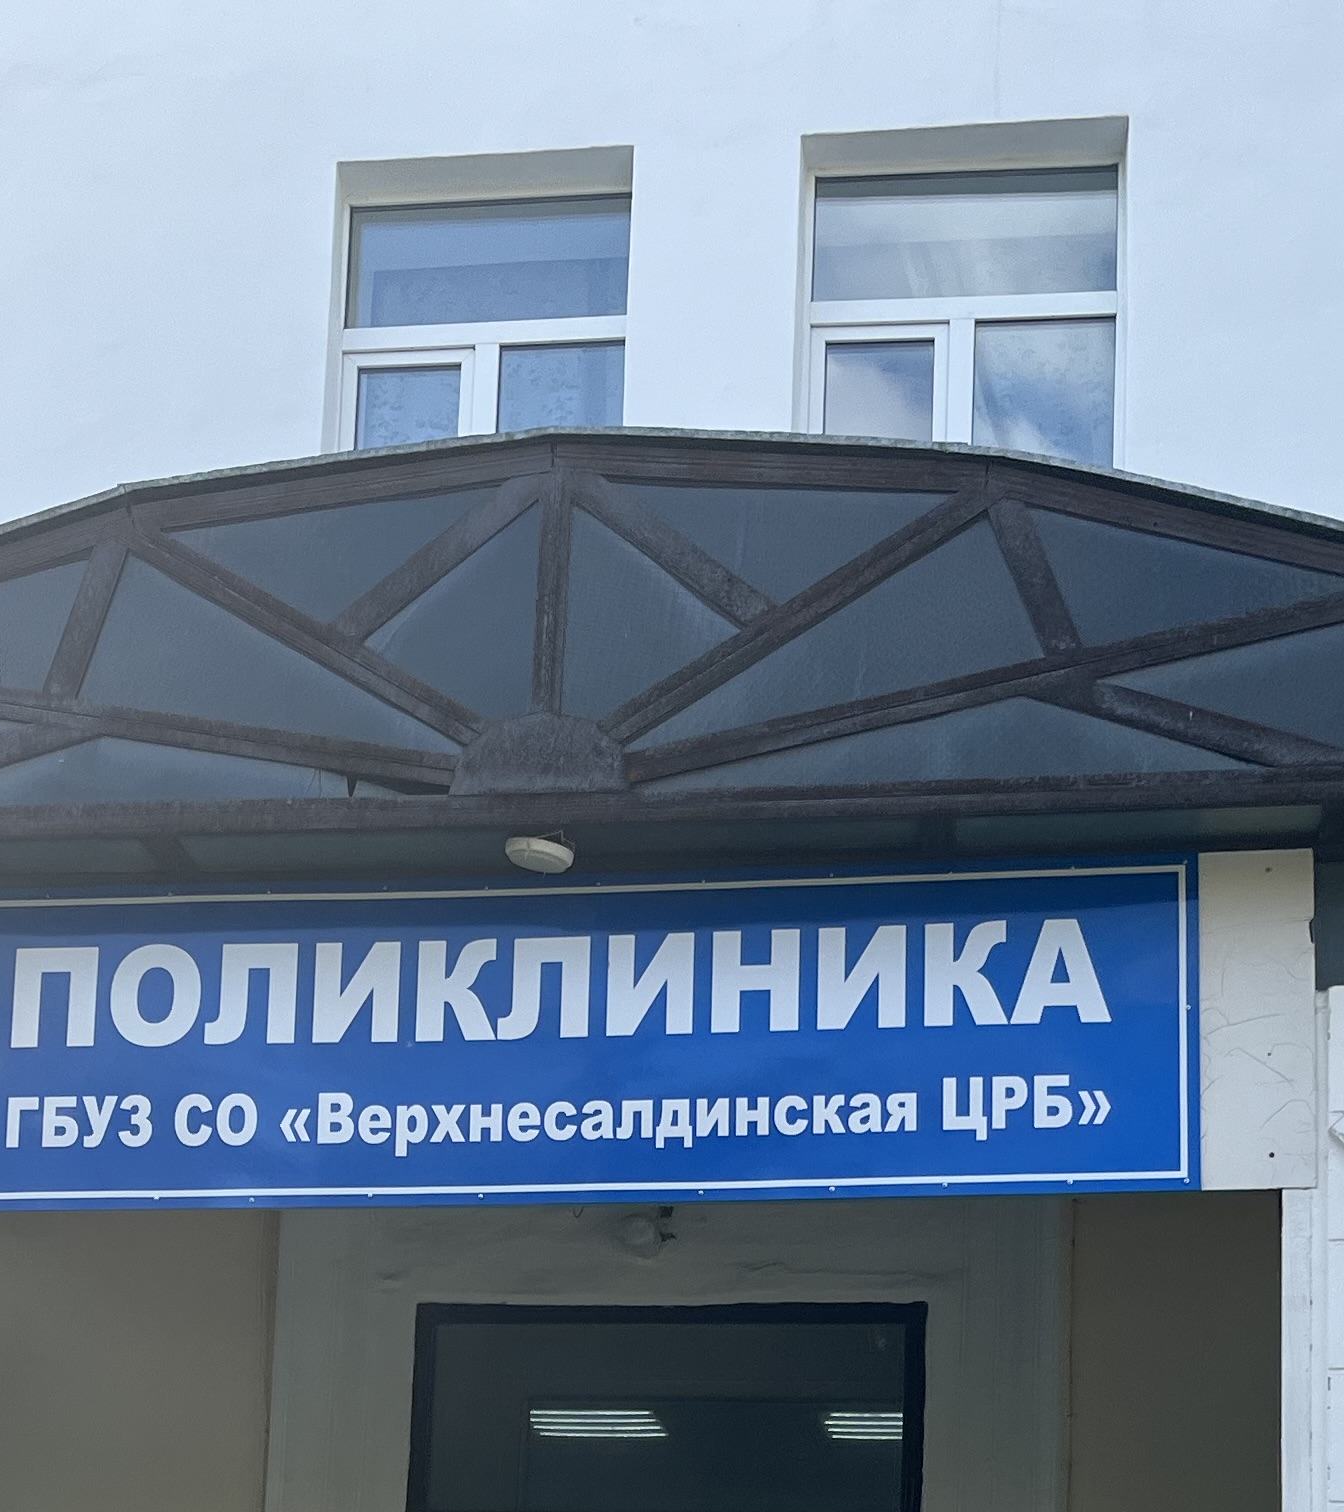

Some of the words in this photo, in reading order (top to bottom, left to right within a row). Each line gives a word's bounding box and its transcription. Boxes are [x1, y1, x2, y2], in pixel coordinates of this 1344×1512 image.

[9, 918, 1113, 1049] ПОЛИКЛИНИКА
[5, 1093, 155, 1149] ГБУЗ
[172, 1093, 259, 1147] СО
[277, 1083, 917, 1157] «Верхнесалдинская
[940, 1074, 1112, 1140] ЦРБ»
